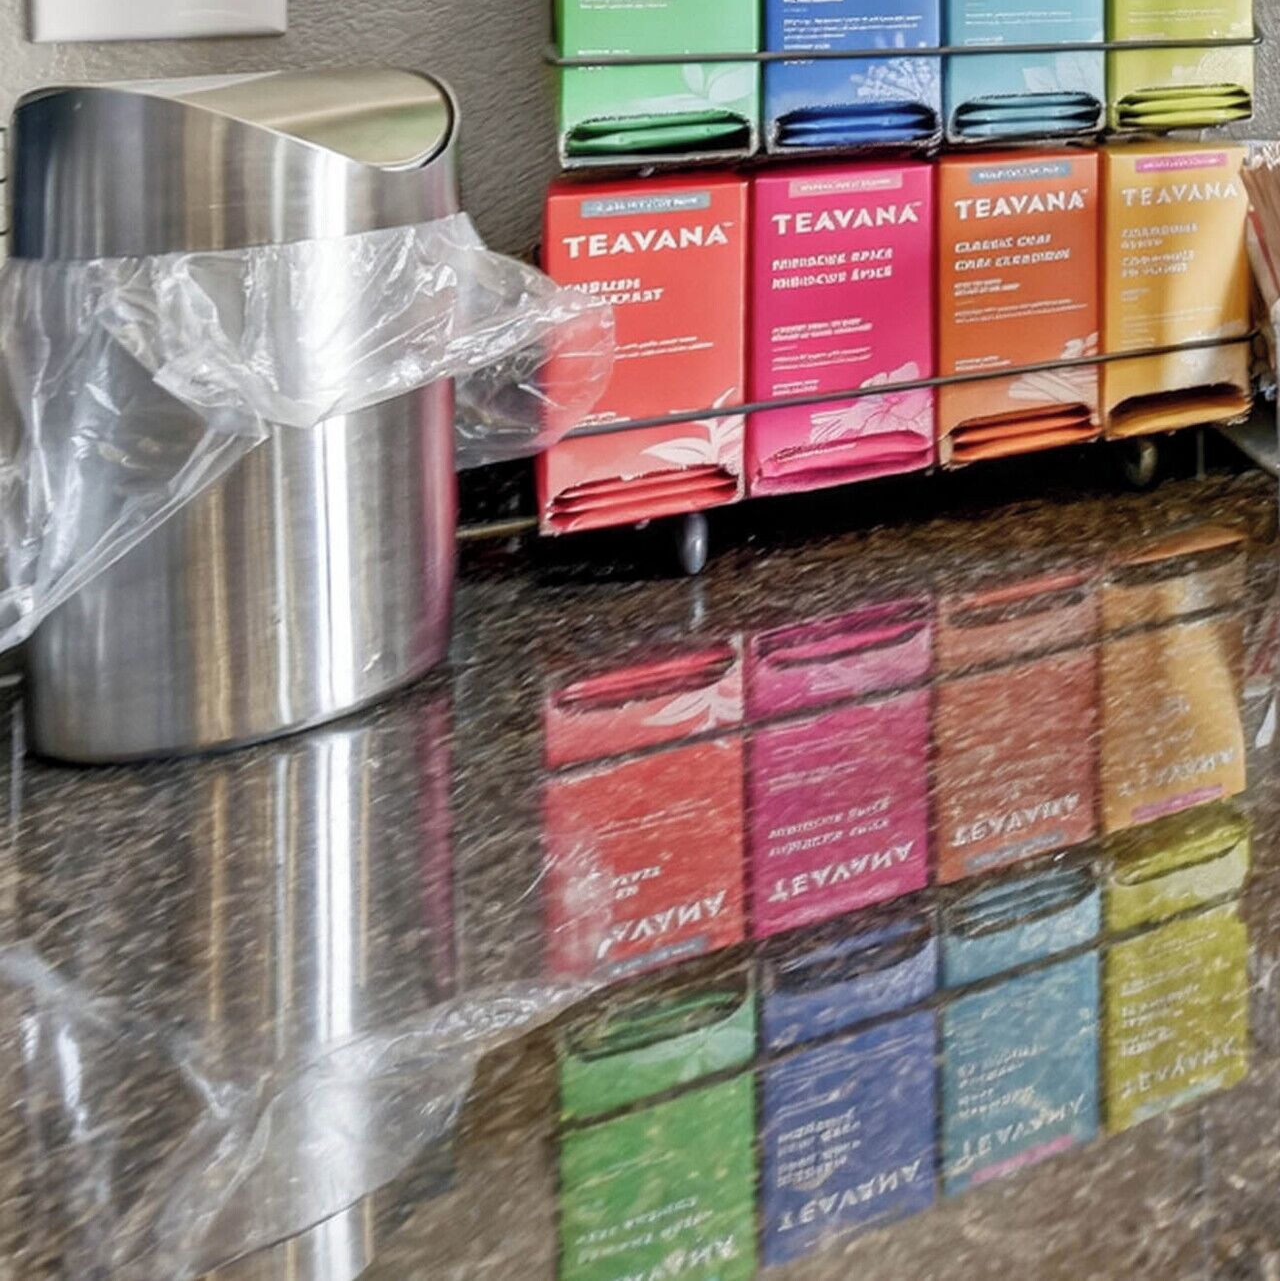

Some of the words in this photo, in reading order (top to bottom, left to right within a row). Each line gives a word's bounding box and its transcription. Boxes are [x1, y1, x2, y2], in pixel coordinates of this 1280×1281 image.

[954, 189, 1086, 220] TEAVANA
[1122, 180, 1240, 207] TEAVANA
[772, 204, 921, 236] TEAVANA
[563, 223, 730, 260] TEAVANA
